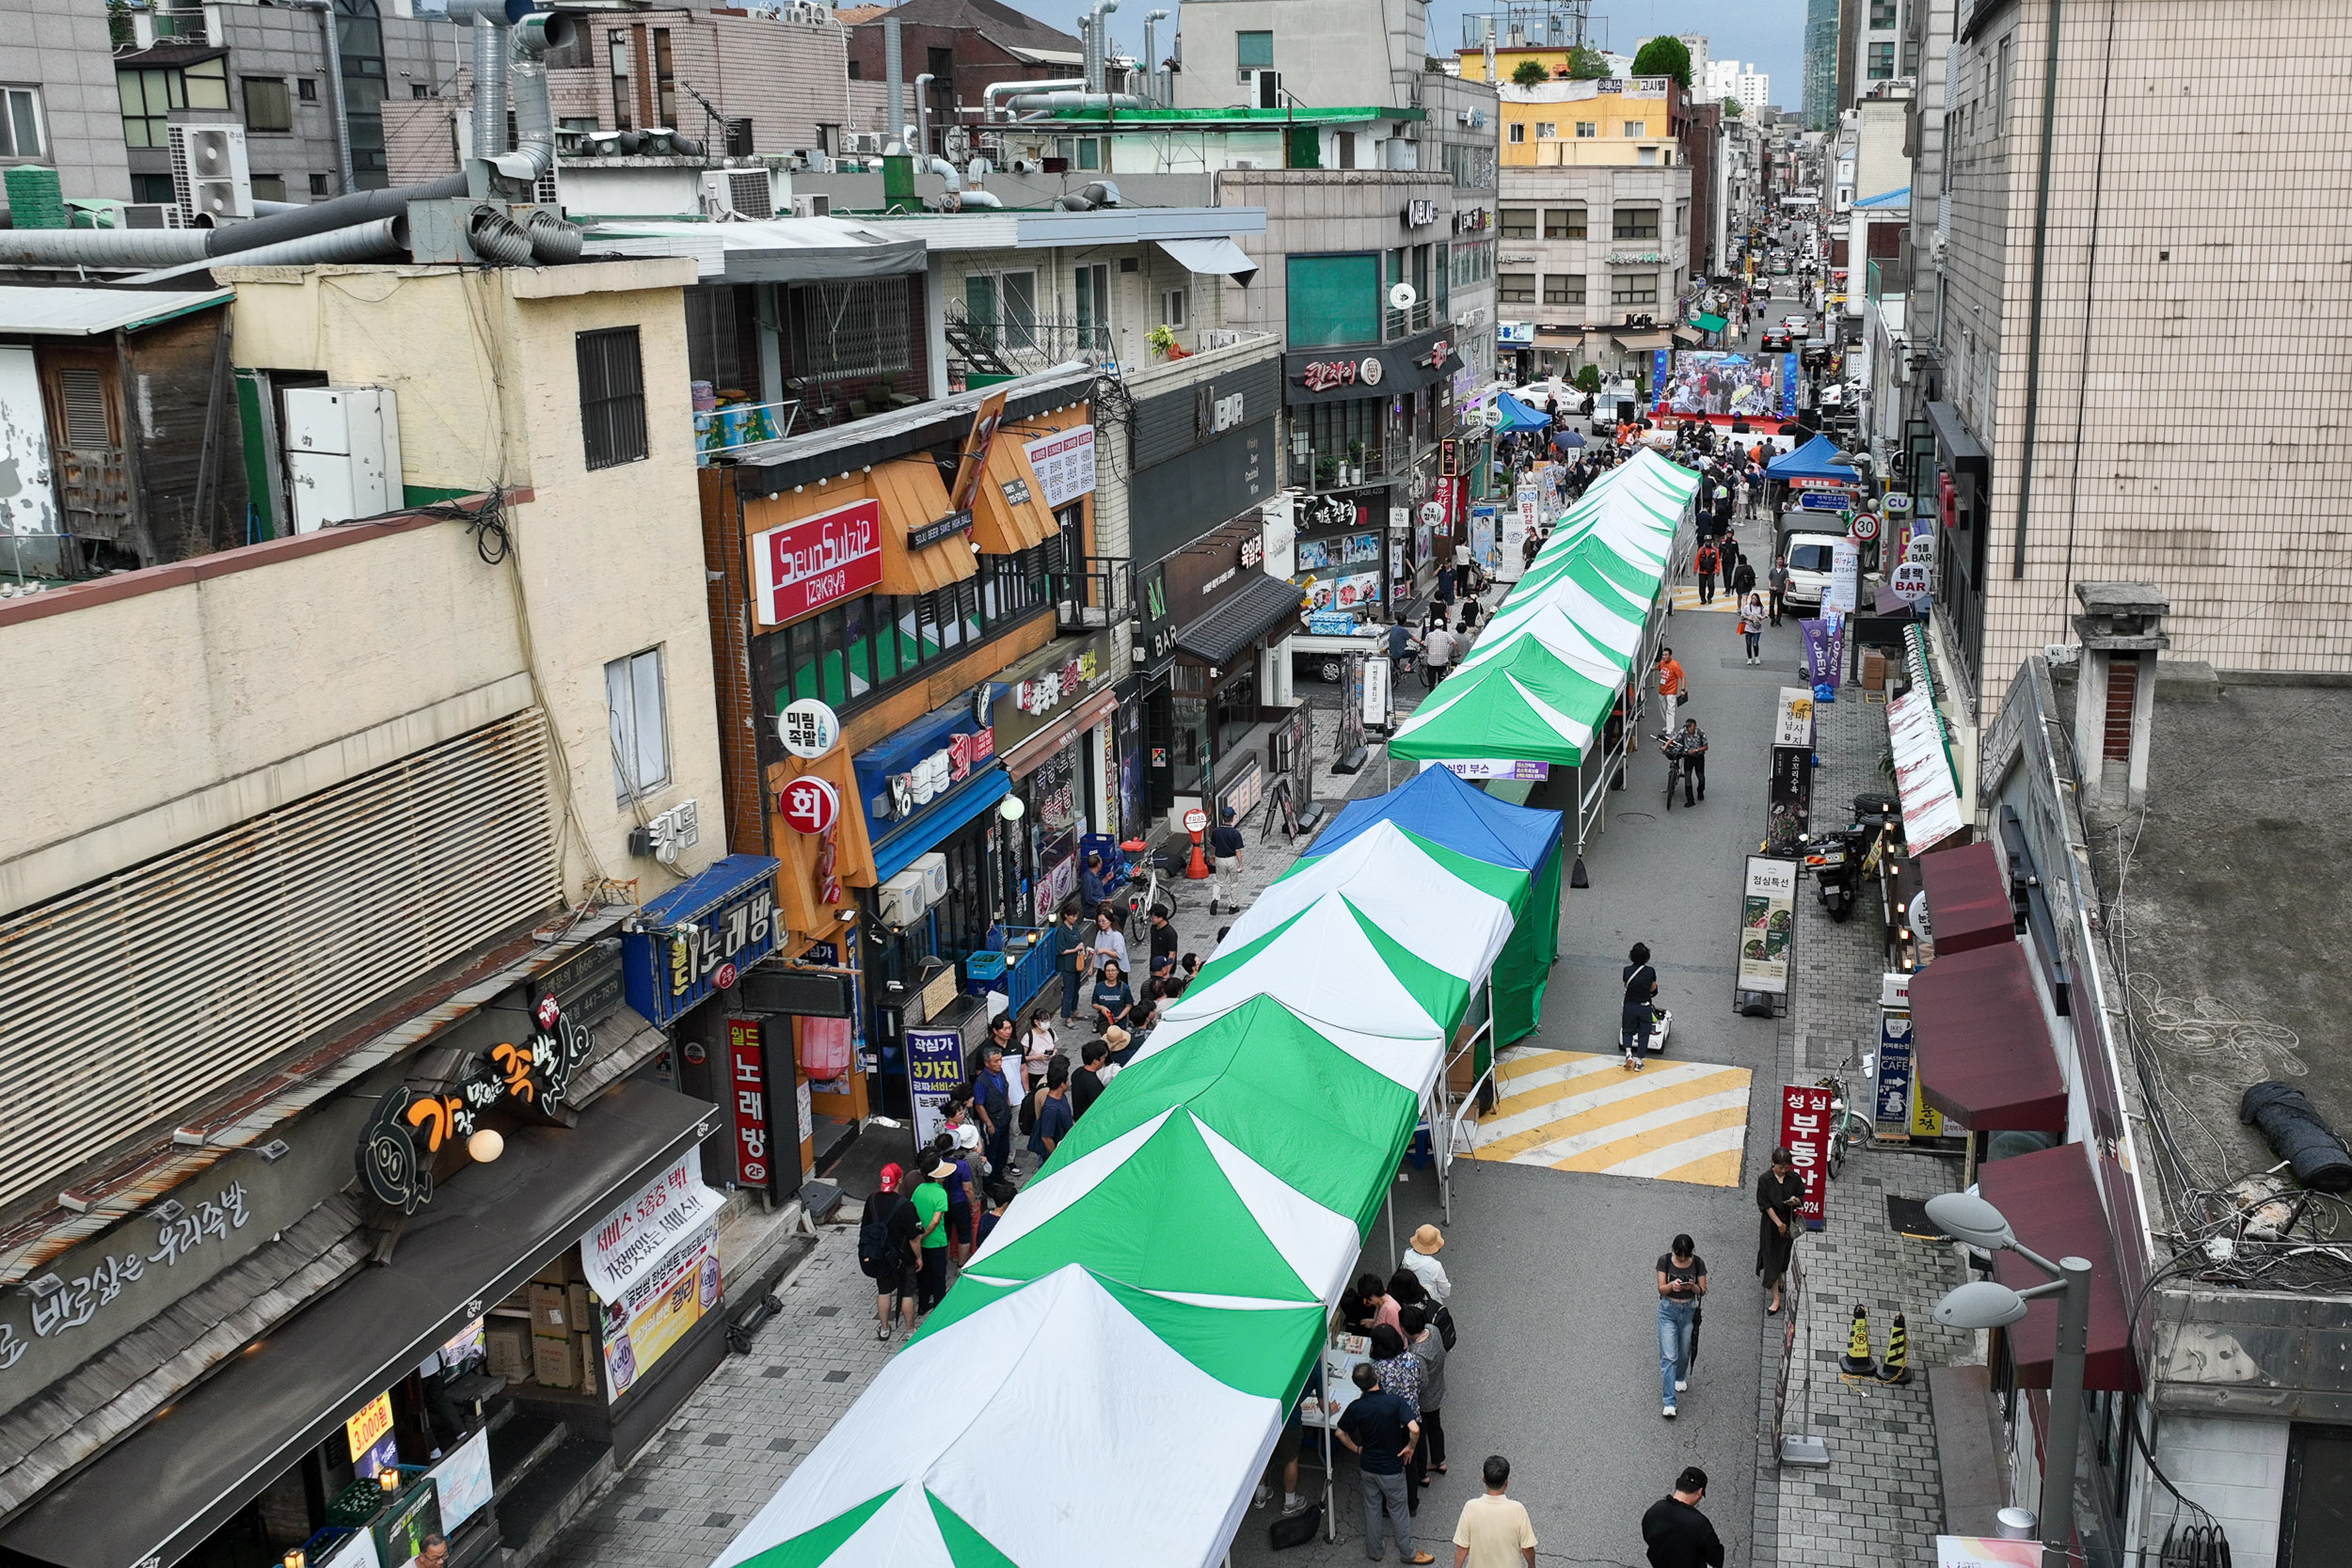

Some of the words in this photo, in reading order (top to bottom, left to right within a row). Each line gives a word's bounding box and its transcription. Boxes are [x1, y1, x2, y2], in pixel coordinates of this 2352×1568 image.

[1215, 393, 1244, 432] BAR
[1249, 484, 1259, 495] Wine
[1887, 498, 1908, 508] CU
[914, 532, 928, 544] SOJU
[928, 528, 940, 540] BEER
[940, 523, 951, 535] SAKE
[1857, 520, 1874, 533] 30
[1912, 553, 1932, 562] BAR
[1899, 567, 1924, 580] 블랙
[805, 569, 846, 607] IZAKAYA
[1895, 582, 1926, 592] BAR
[1155, 625, 1178, 657] BAR
[1829, 641, 1841, 676] OPEN
[787, 712, 815, 730] 미림
[789, 730, 816, 747] 족발
[1470, 763, 1489, 774] 부스
[1790, 754, 1801, 794] 소꼬리수육
[788, 787, 821, 828] 회
[1753, 875, 1789, 889] 점심특선
[700, 890, 772, 974] 노래방
[583, 980, 619, 1011] 447-7879
[730, 1027, 760, 1047] 월드
[914, 1037, 954, 1053] 작심가
[467, 1074, 505, 1109] 맛있는
[491, 1033, 560, 1103] 족발
[913, 1060, 960, 1080] 3가지
[1881, 1061, 1909, 1070] CAFE
[735, 1053, 768, 1158] 노래방
[748, 1165, 764, 1177] 2F
[596, 1213, 634, 1258] 서비스
[32, 1255, 144, 1338] 바로삶은
[148, 1182, 251, 1267] 우리족발
[699, 1269, 717, 1291] Kelly
[672, 1272, 697, 1315] 켈리
[611, 1346, 631, 1375] Kelly
[353, 1405, 389, 1453] 3,000원
